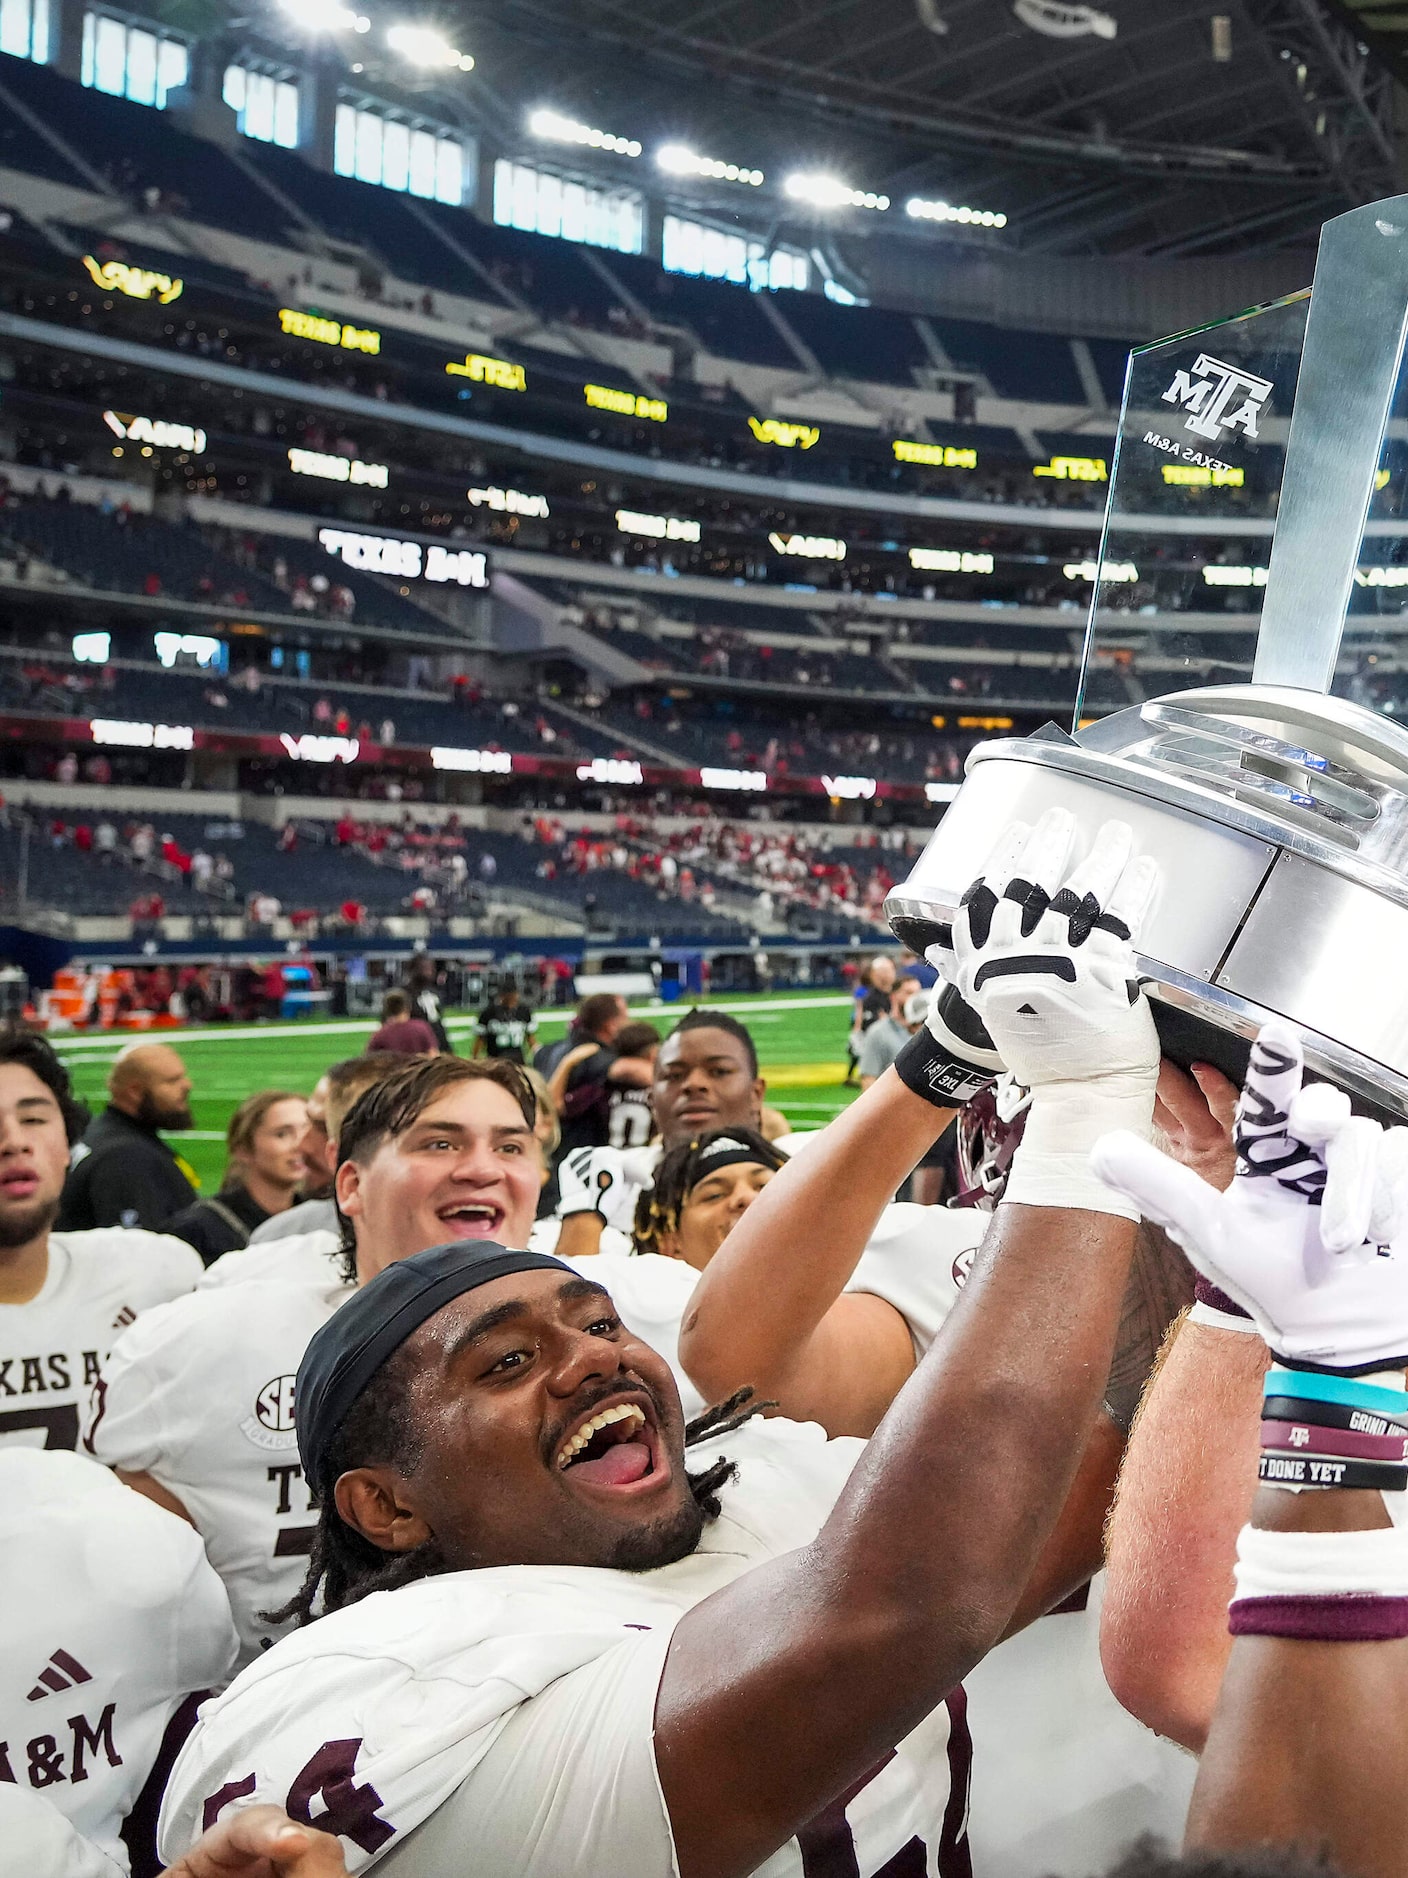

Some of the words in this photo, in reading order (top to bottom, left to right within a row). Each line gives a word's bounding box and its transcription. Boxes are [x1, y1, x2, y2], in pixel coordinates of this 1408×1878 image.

[319, 528, 422, 577] TEXAS
[938, 1074, 960, 1091] 3XL
[1350, 1411, 1387, 1436] GRIND
[1268, 1459, 1305, 1480] DONE
[1309, 1462, 1346, 1482] YET
